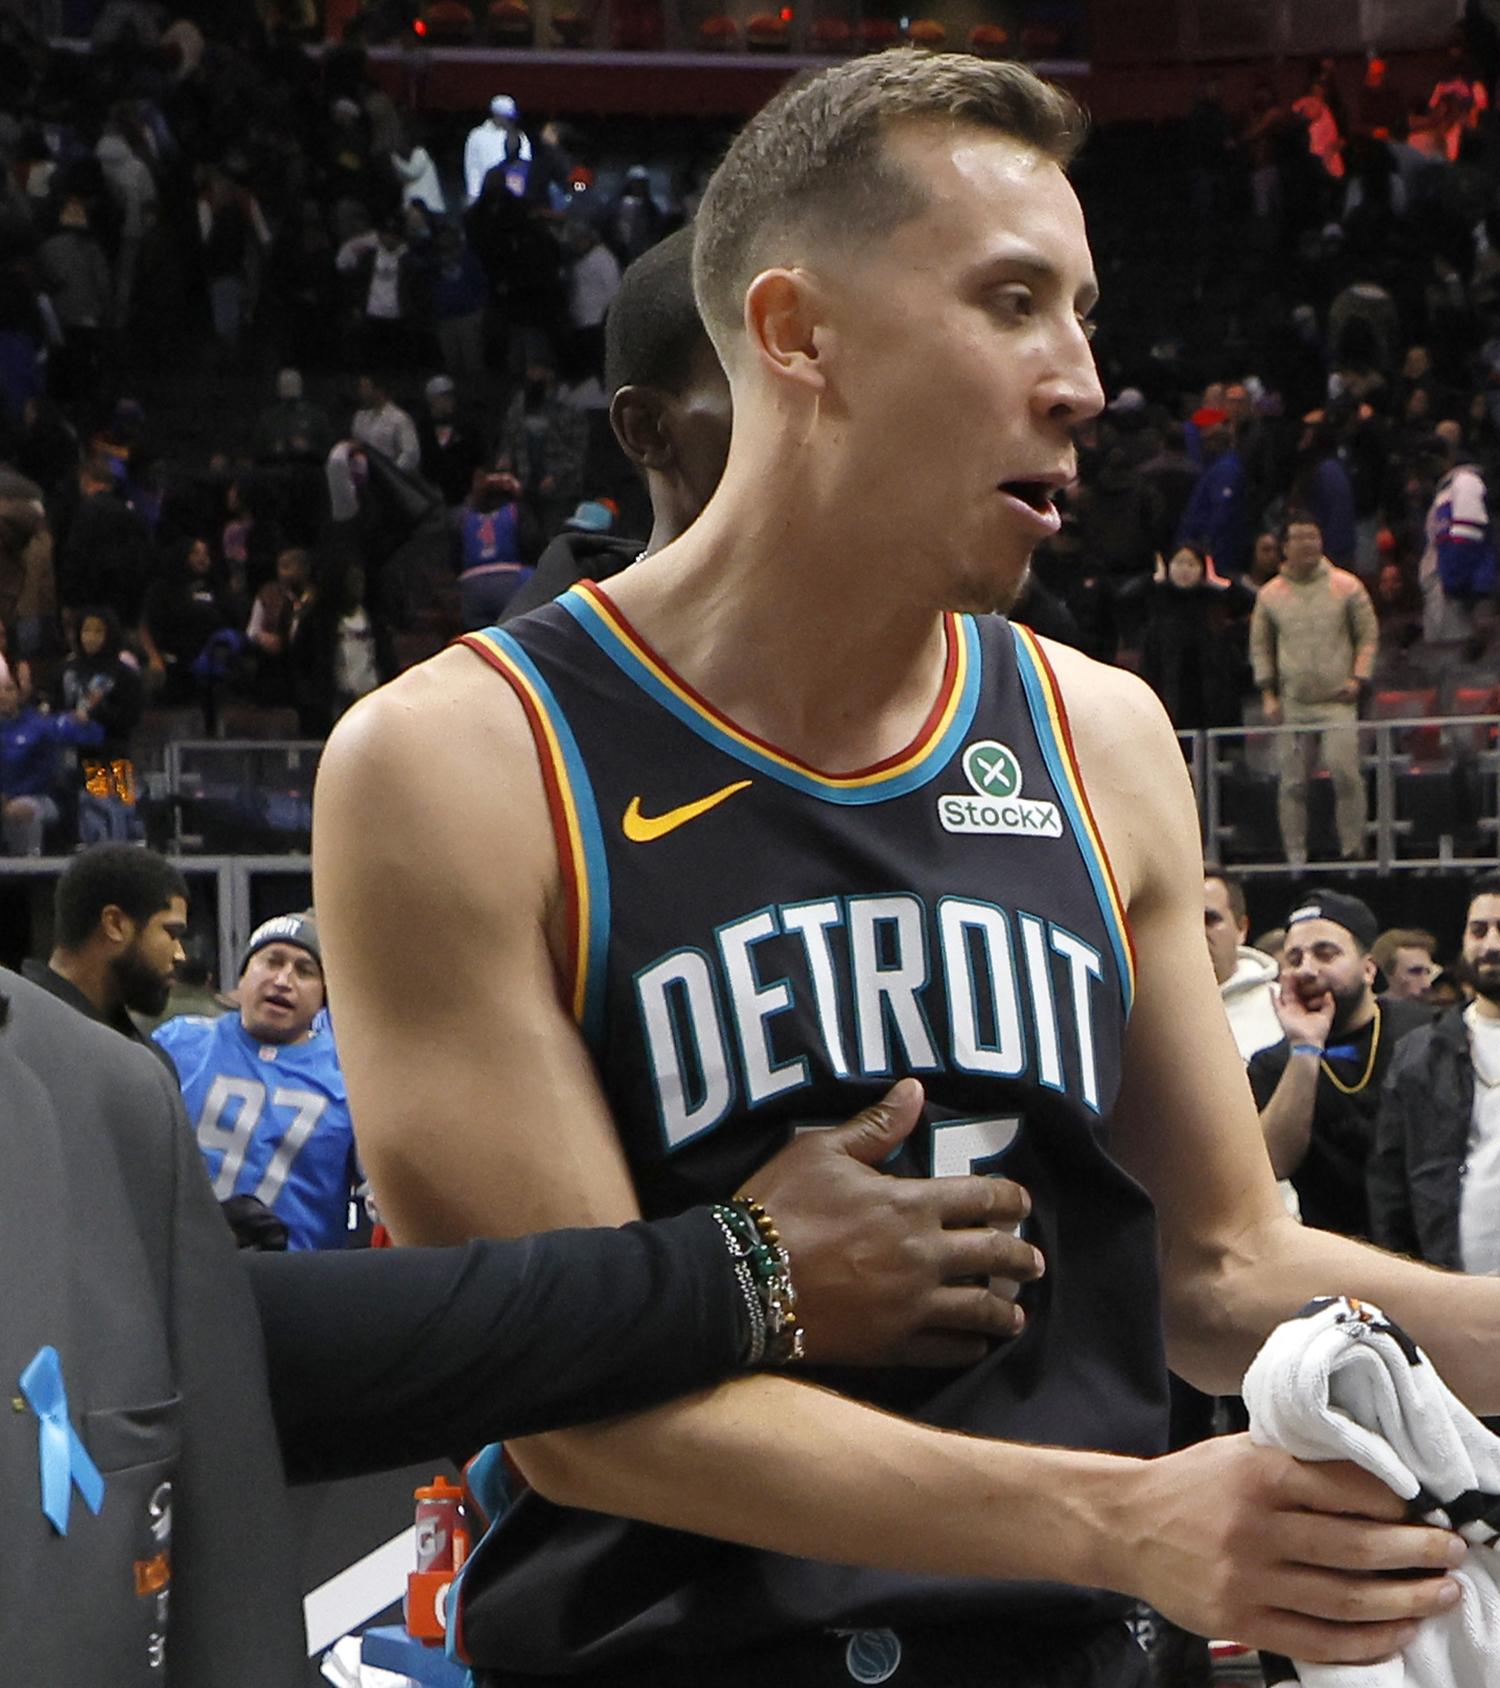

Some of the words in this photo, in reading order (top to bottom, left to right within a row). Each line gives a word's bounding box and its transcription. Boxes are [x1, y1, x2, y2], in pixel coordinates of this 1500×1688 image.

[944, 801, 1058, 831] StockX
[634, 892, 1103, 1152] DETROIT
[197, 1074, 328, 1208] 97
